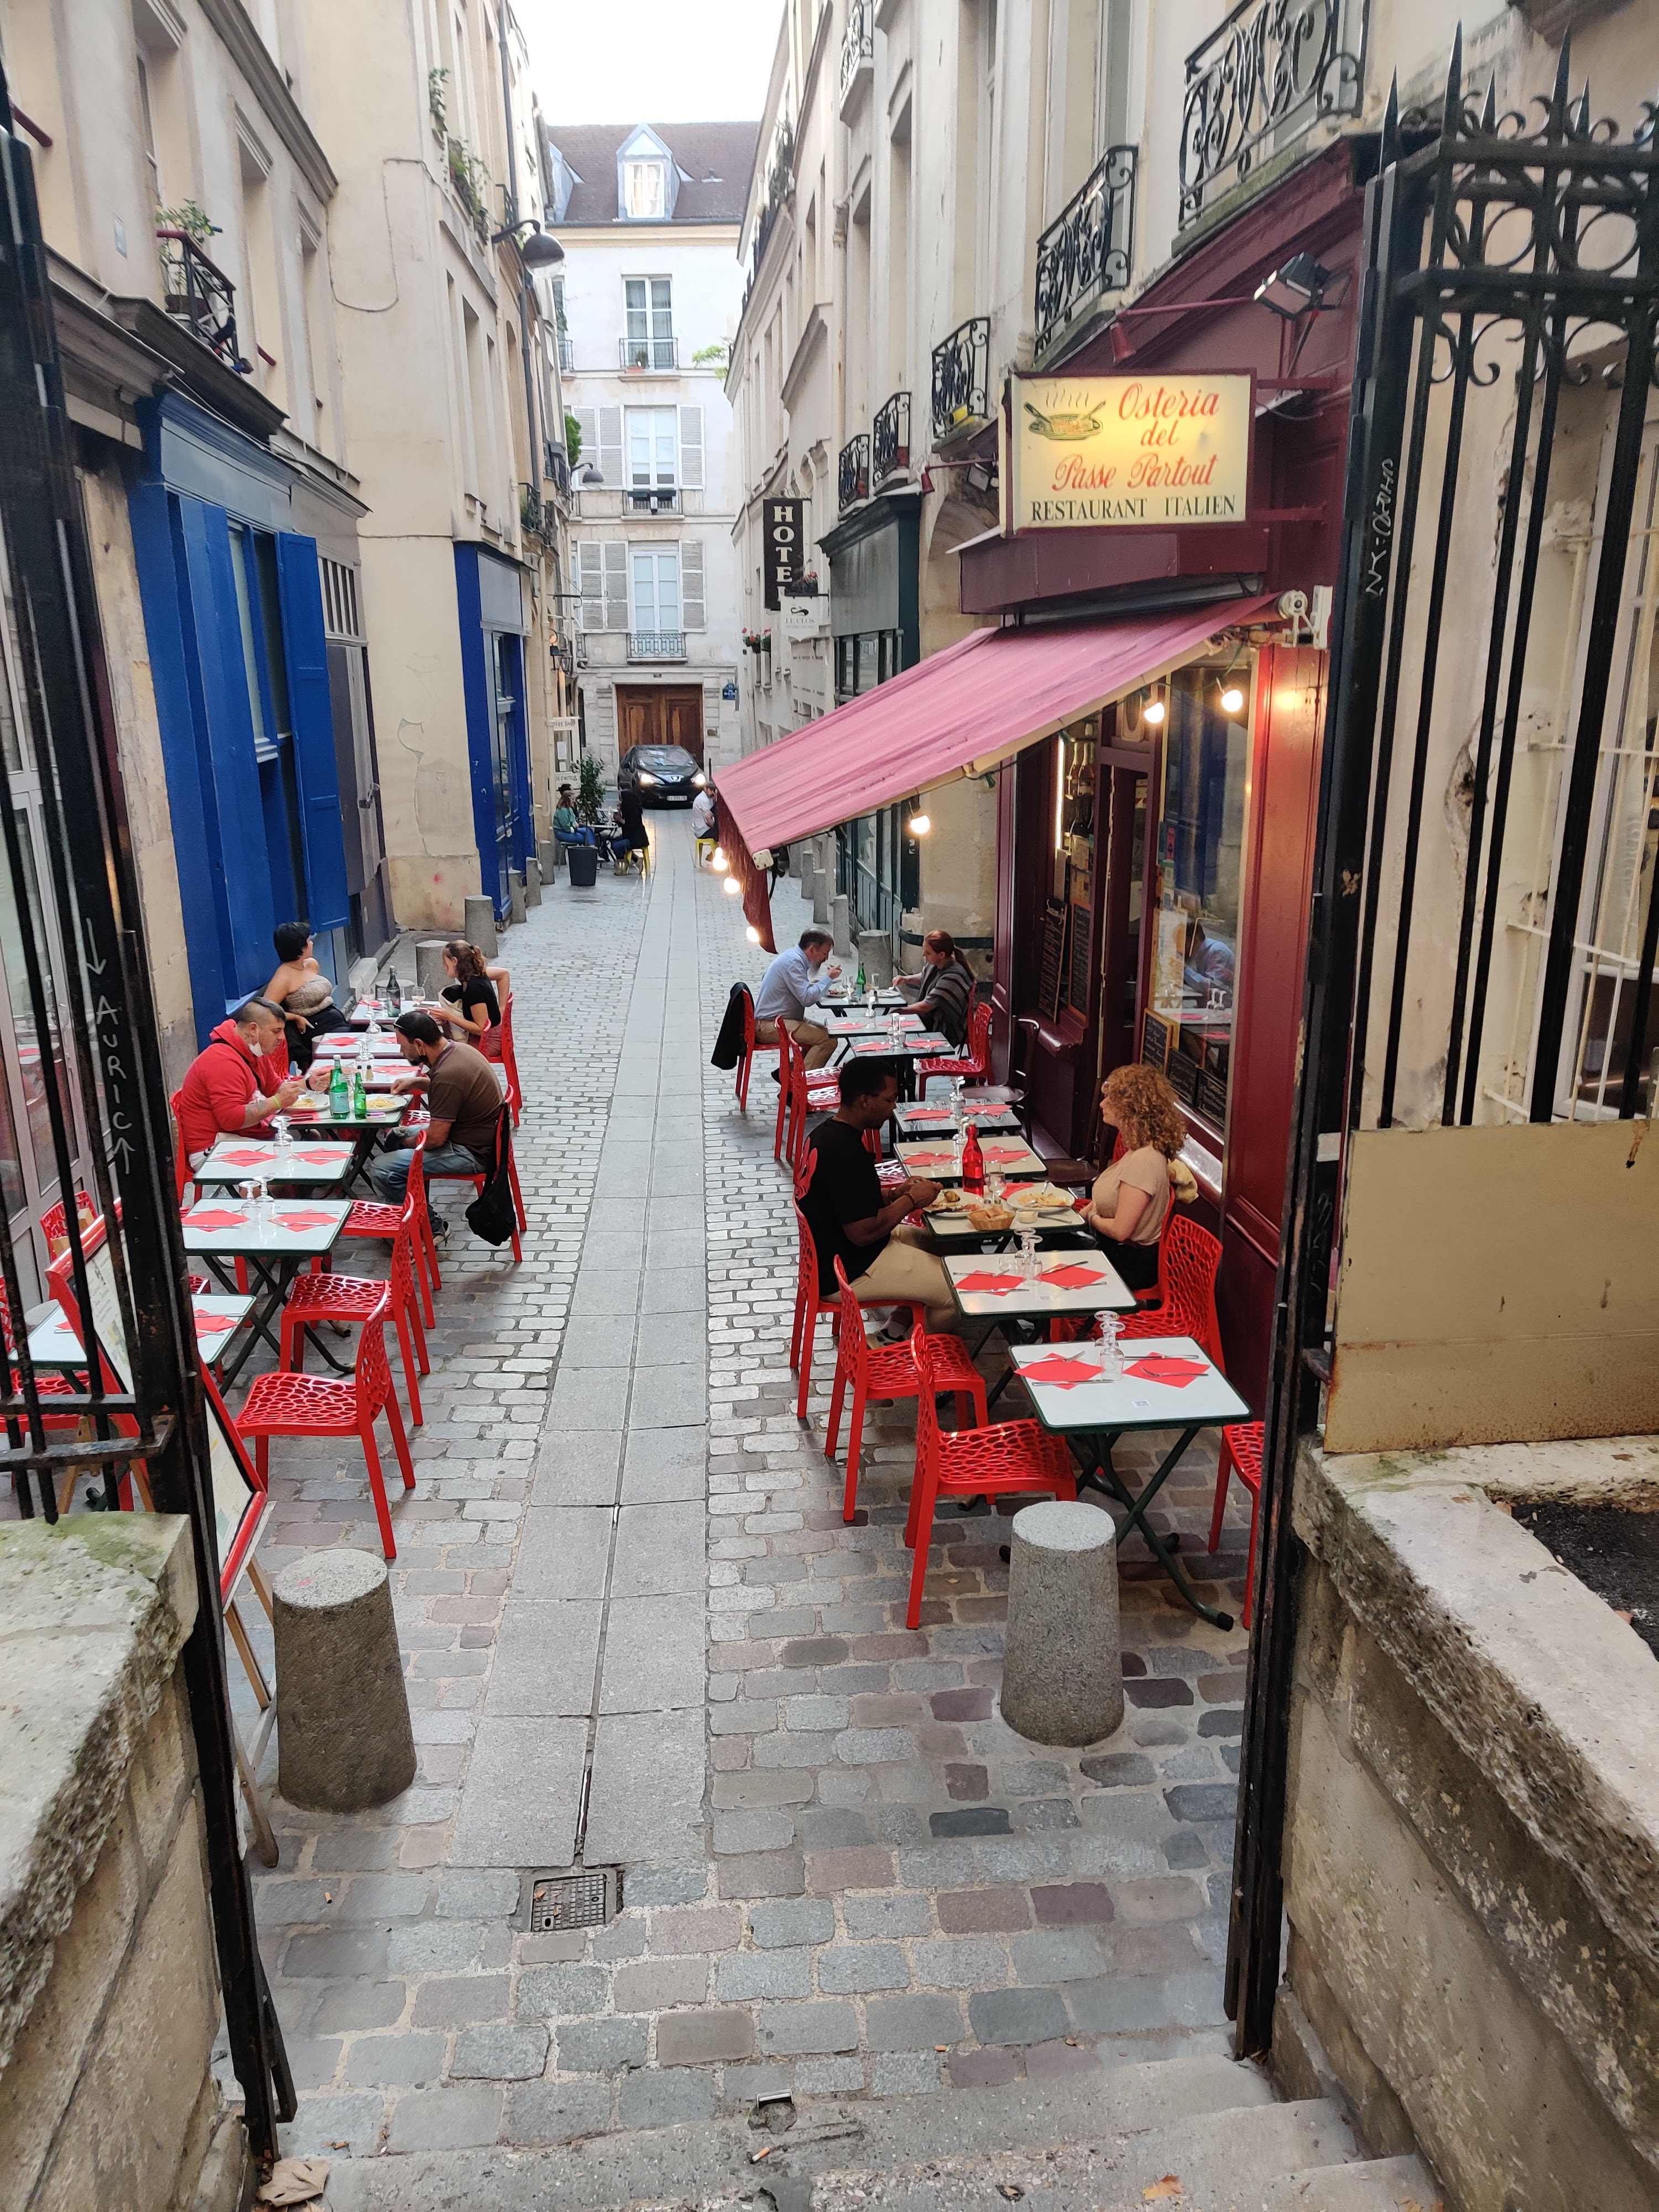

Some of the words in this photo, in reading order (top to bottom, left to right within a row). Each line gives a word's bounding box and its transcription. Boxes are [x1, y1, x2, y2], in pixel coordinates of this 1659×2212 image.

[1118, 382, 1220, 421] Osteria
[1140, 420, 1179, 447] del
[1051, 453, 1117, 492] Passe
[1126, 452, 1219, 489] Partout
[1030, 497, 1147, 522] RESTAURANT
[1164, 494, 1236, 517] ITALIEN
[96, 995, 133, 1130] AURIC
